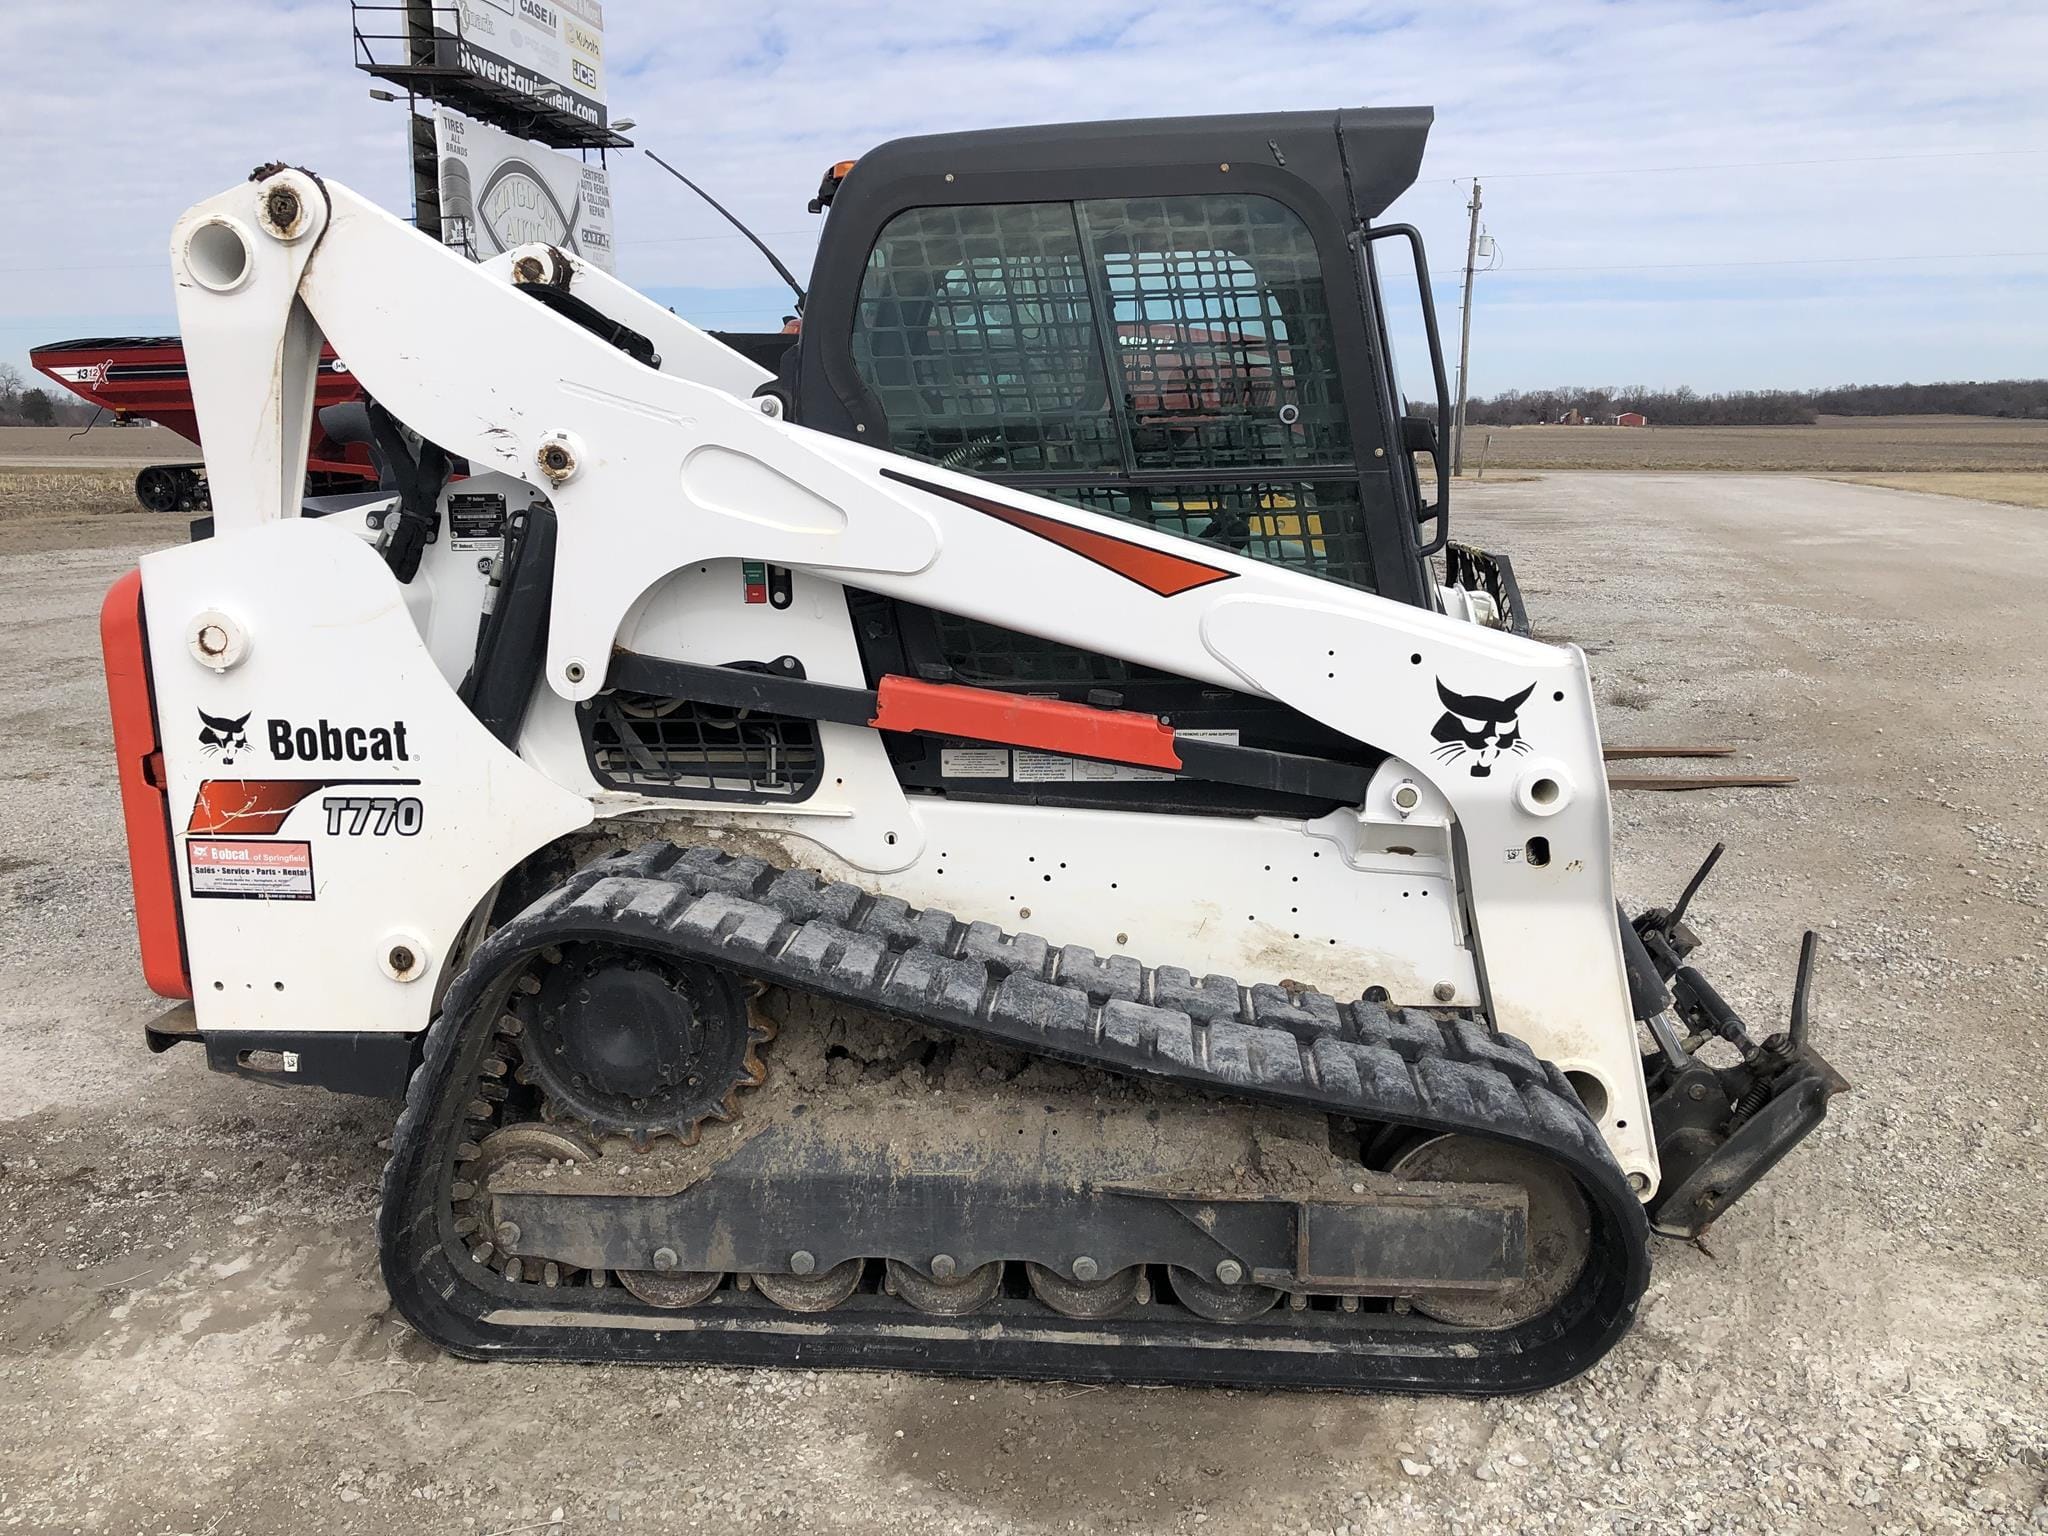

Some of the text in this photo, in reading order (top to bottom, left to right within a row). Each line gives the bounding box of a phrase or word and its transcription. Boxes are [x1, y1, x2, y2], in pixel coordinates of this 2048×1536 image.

[520, 0, 547, 23] CASE
[575, 30, 600, 55] Kubota
[573, 60, 597, 89] JCB
[443, 117, 465, 135] TIRES
[451, 133, 461, 144] ALL
[446, 142, 468, 157] BRANDS
[582, 167, 605, 185] CERTIFIED
[581, 179, 609, 197] AUTO REPAIR
[587, 192, 610, 208] COLLISION
[489, 181, 560, 242] KINGDOM
[589, 204, 605, 219] REPAIR
[582, 229, 610, 248] CARFAX
[267, 719, 409, 761] Bobcat
[322, 797, 423, 836] T770
[211, 847, 249, 860] Bobcat
[263, 854, 306, 863] Springfield
[222, 867, 250, 875] Service
